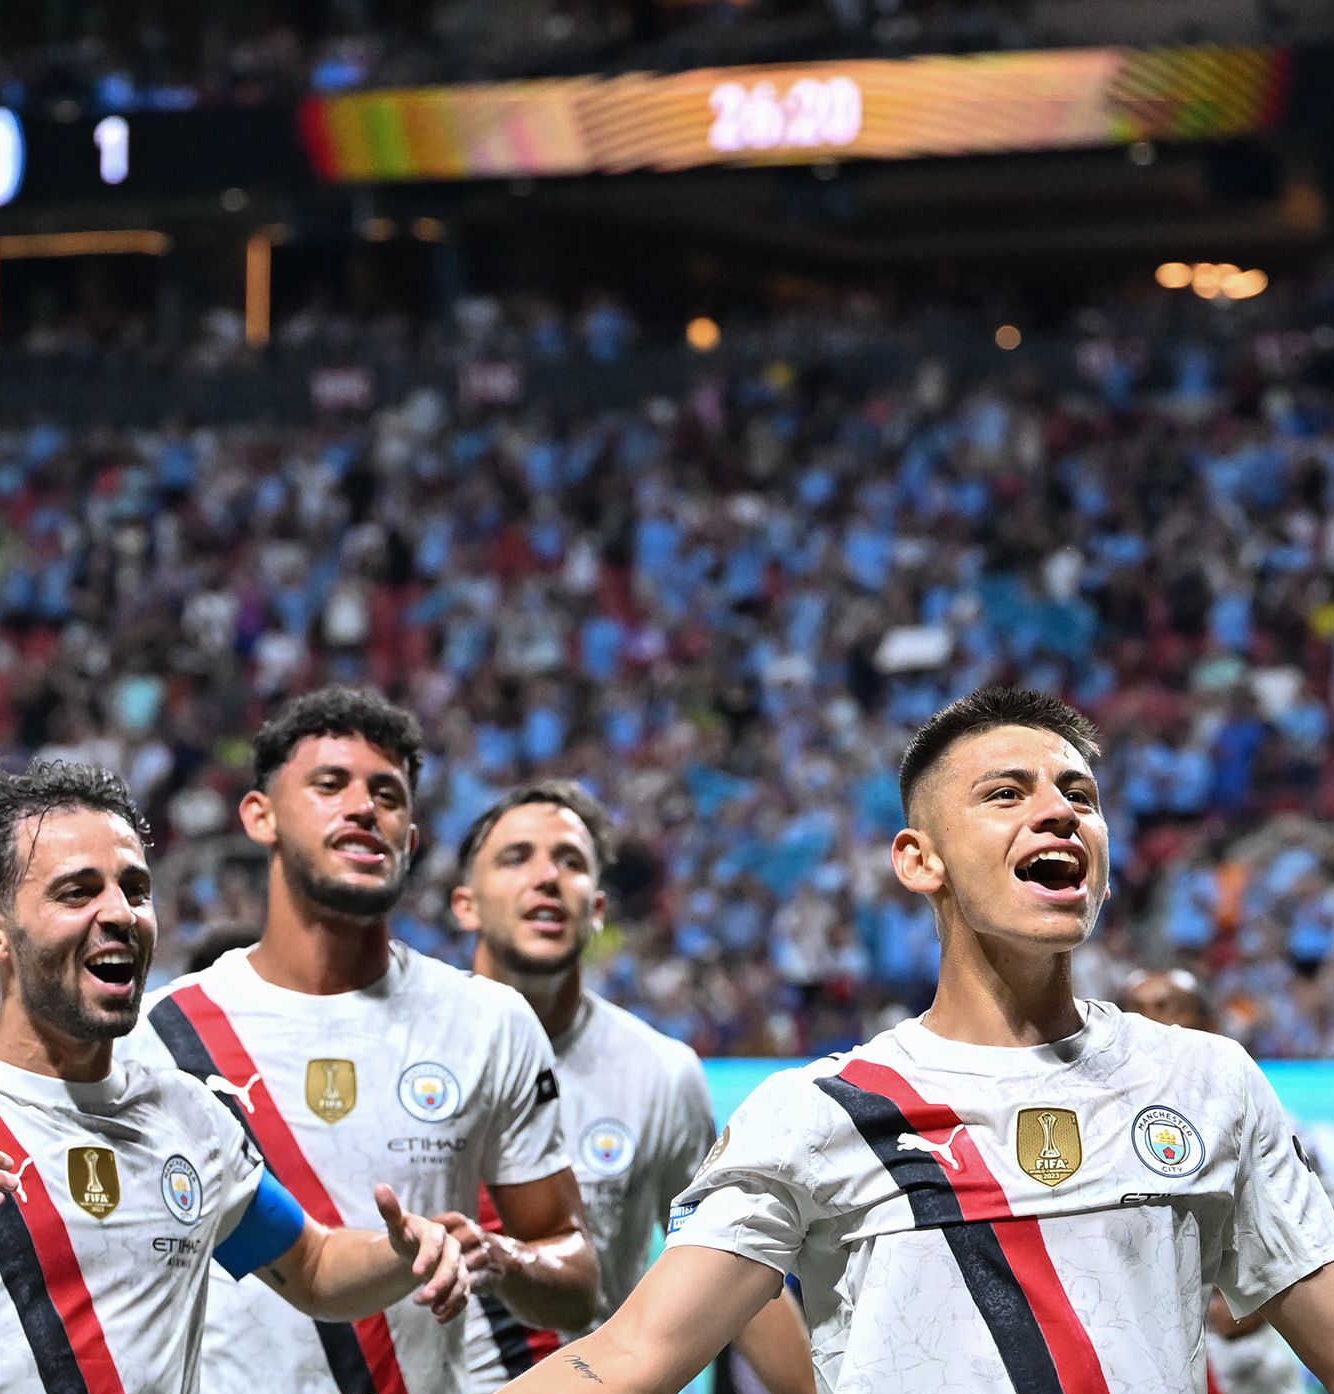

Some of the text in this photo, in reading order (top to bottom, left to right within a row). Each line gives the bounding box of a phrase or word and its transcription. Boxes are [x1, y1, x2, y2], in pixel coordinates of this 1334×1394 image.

[93, 116, 129, 184] 1
[1138, 1111, 1193, 1137] MANCHESTER
[1035, 1159, 1067, 1170] FIFA
[1161, 1165, 1183, 1173] CITY
[84, 1192, 109, 1203] FIFA
